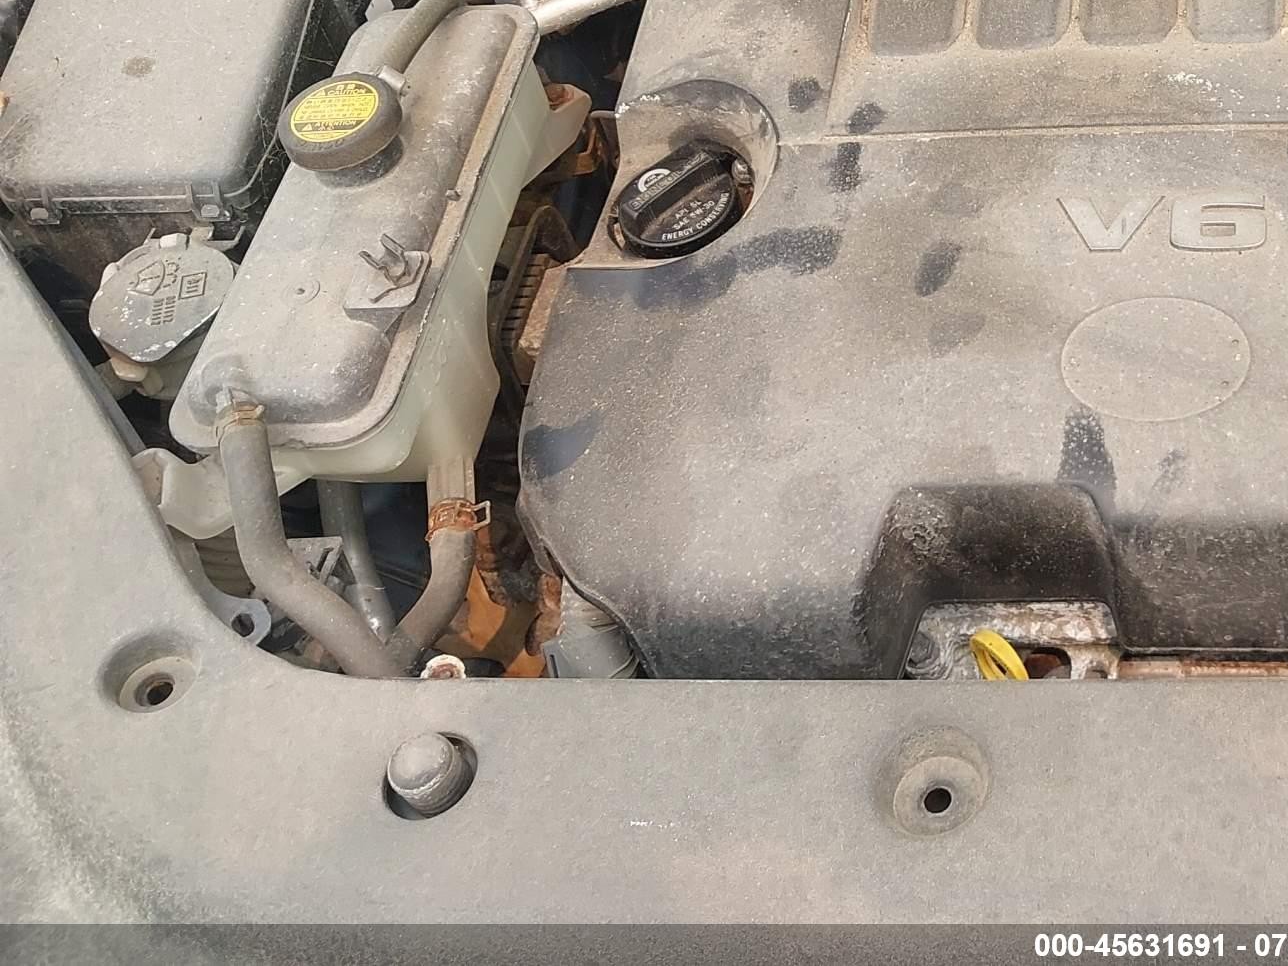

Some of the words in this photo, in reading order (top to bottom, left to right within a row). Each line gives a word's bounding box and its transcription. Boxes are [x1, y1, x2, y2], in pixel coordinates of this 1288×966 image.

[661, 227, 694, 242] ENERGY
[695, 192, 730, 230] CONSERVING
[672, 218, 690, 231] SAE
[1056, 194, 1268, 254] V6
